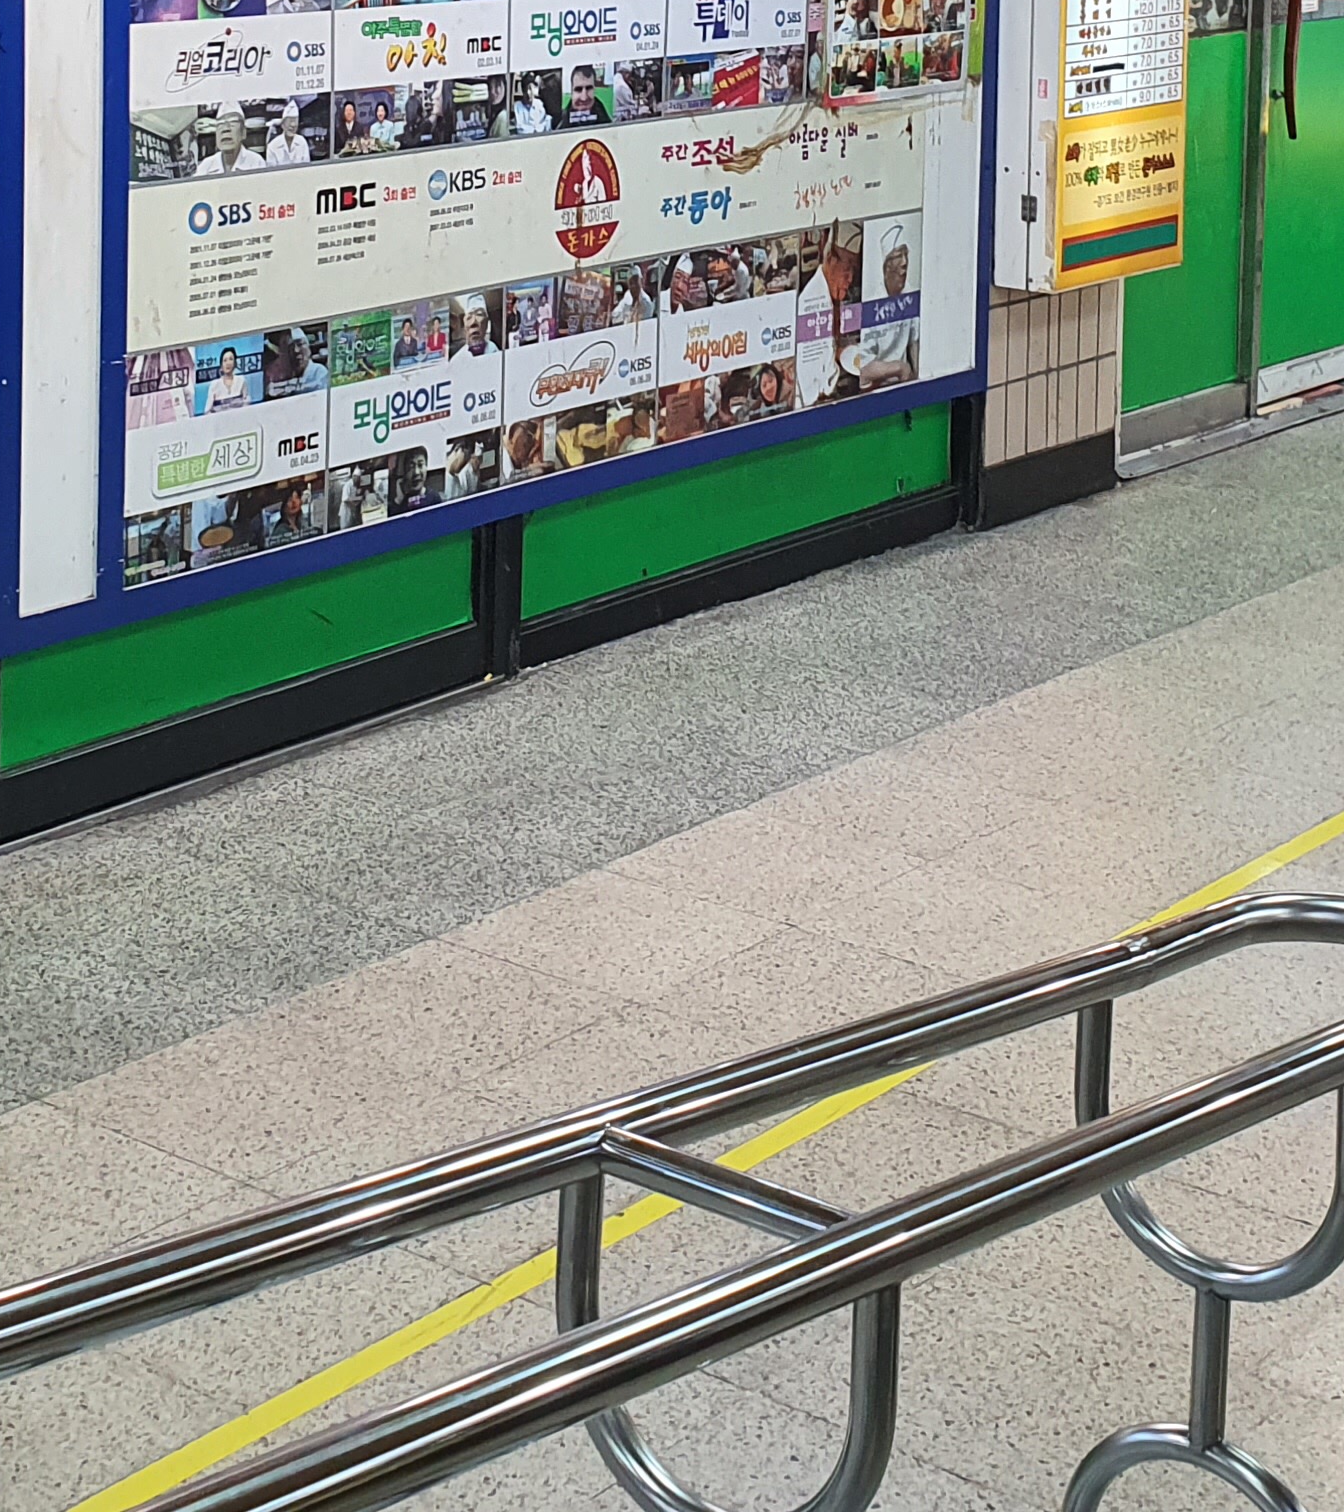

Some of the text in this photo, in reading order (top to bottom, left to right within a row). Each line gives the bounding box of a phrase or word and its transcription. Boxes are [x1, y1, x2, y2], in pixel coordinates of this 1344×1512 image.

[530, 7, 660, 56] 모닝와이드 SBS
[786, 11, 802, 24] SBS
[175, 42, 325, 83] 리얼코리아 SBS
[661, 136, 736, 167] 주간 조선
[450, 168, 522, 193] KBS 2회 출연
[316, 182, 416, 215] MBC 3회 출연
[661, 186, 732, 225] 주간 동아
[218, 202, 296, 226] SBS 5회 출연
[567, 228, 609, 253] 돈가스
[771, 325, 792, 340] KBS
[630, 356, 652, 372] KBS
[353, 380, 496, 444] 모닝와이드 SBS
[158, 441, 188, 461] 공감!
[159, 439, 253, 482] 특별한 세상
